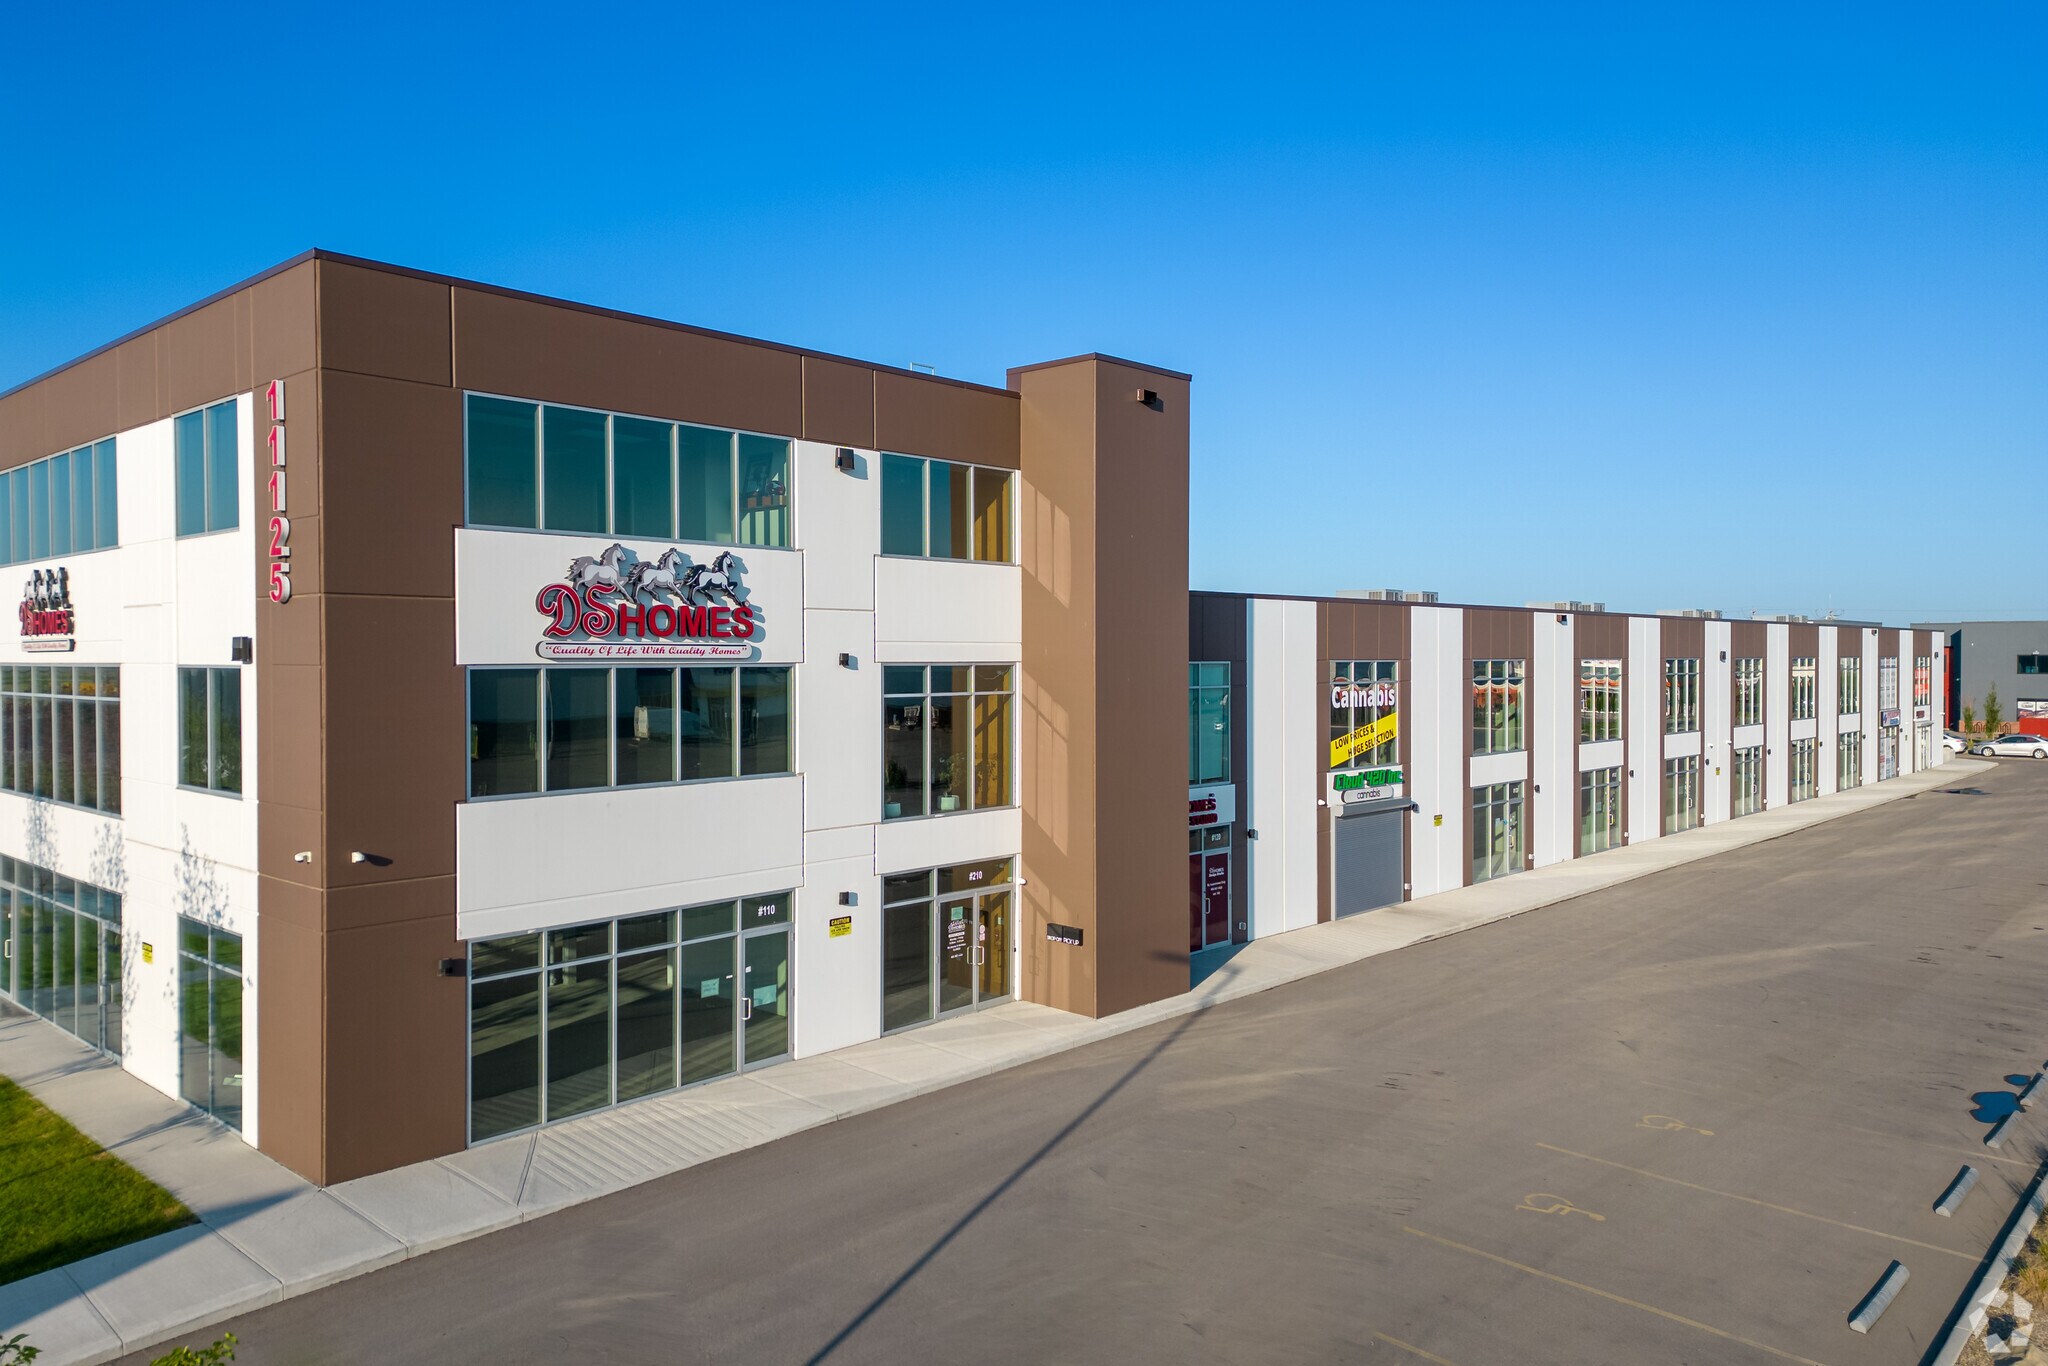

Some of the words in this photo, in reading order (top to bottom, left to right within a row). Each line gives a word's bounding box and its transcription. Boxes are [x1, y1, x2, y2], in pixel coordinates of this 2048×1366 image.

[266, 379, 291, 603] 11125
[33, 609, 69, 635] HOMES
[618, 603, 755, 638] HOMES
[598, 645, 613, 656] Of
[615, 646, 638, 656] Life
[640, 646, 665, 655] With
[668, 646, 707, 657] Quality
[1331, 683, 1395, 709] Cannabis
[1334, 735, 1349, 749] LOW
[1334, 772, 1364, 791] Cloud
[1365, 769, 1386, 787] 420
[1356, 789, 1381, 799] cannabis
[757, 904, 776, 917] #110
